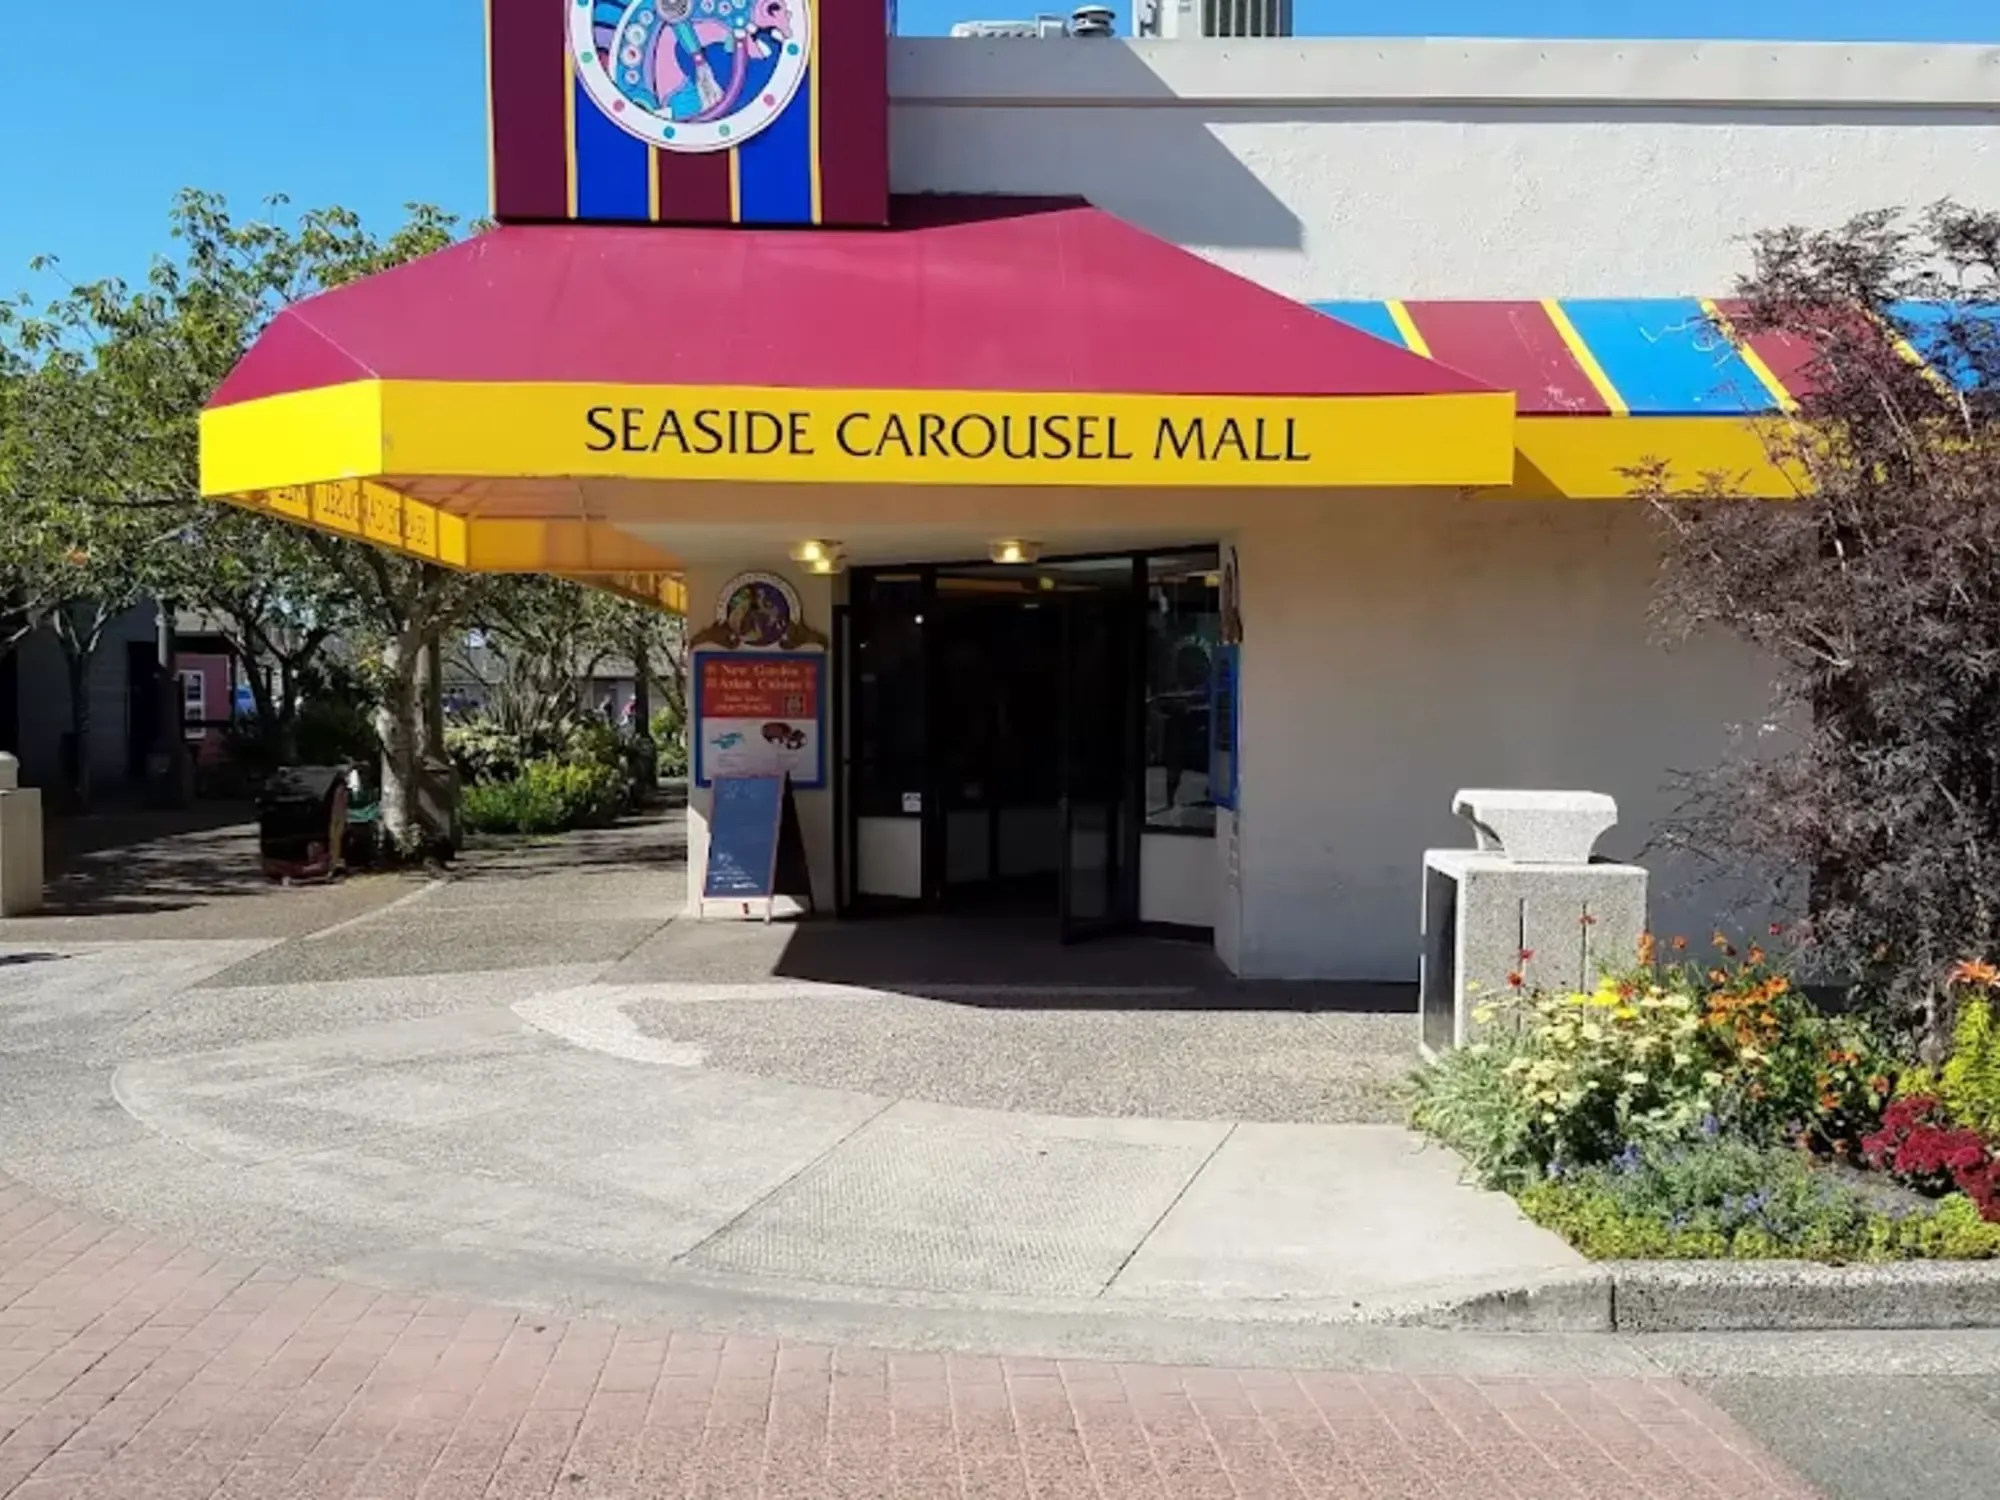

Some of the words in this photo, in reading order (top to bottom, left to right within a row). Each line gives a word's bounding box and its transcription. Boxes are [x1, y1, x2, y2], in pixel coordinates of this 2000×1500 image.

[586, 406, 814, 455] SEASIDE
[836, 412, 1133, 460] CAROUSEL
[1153, 416, 1311, 462] MALL
